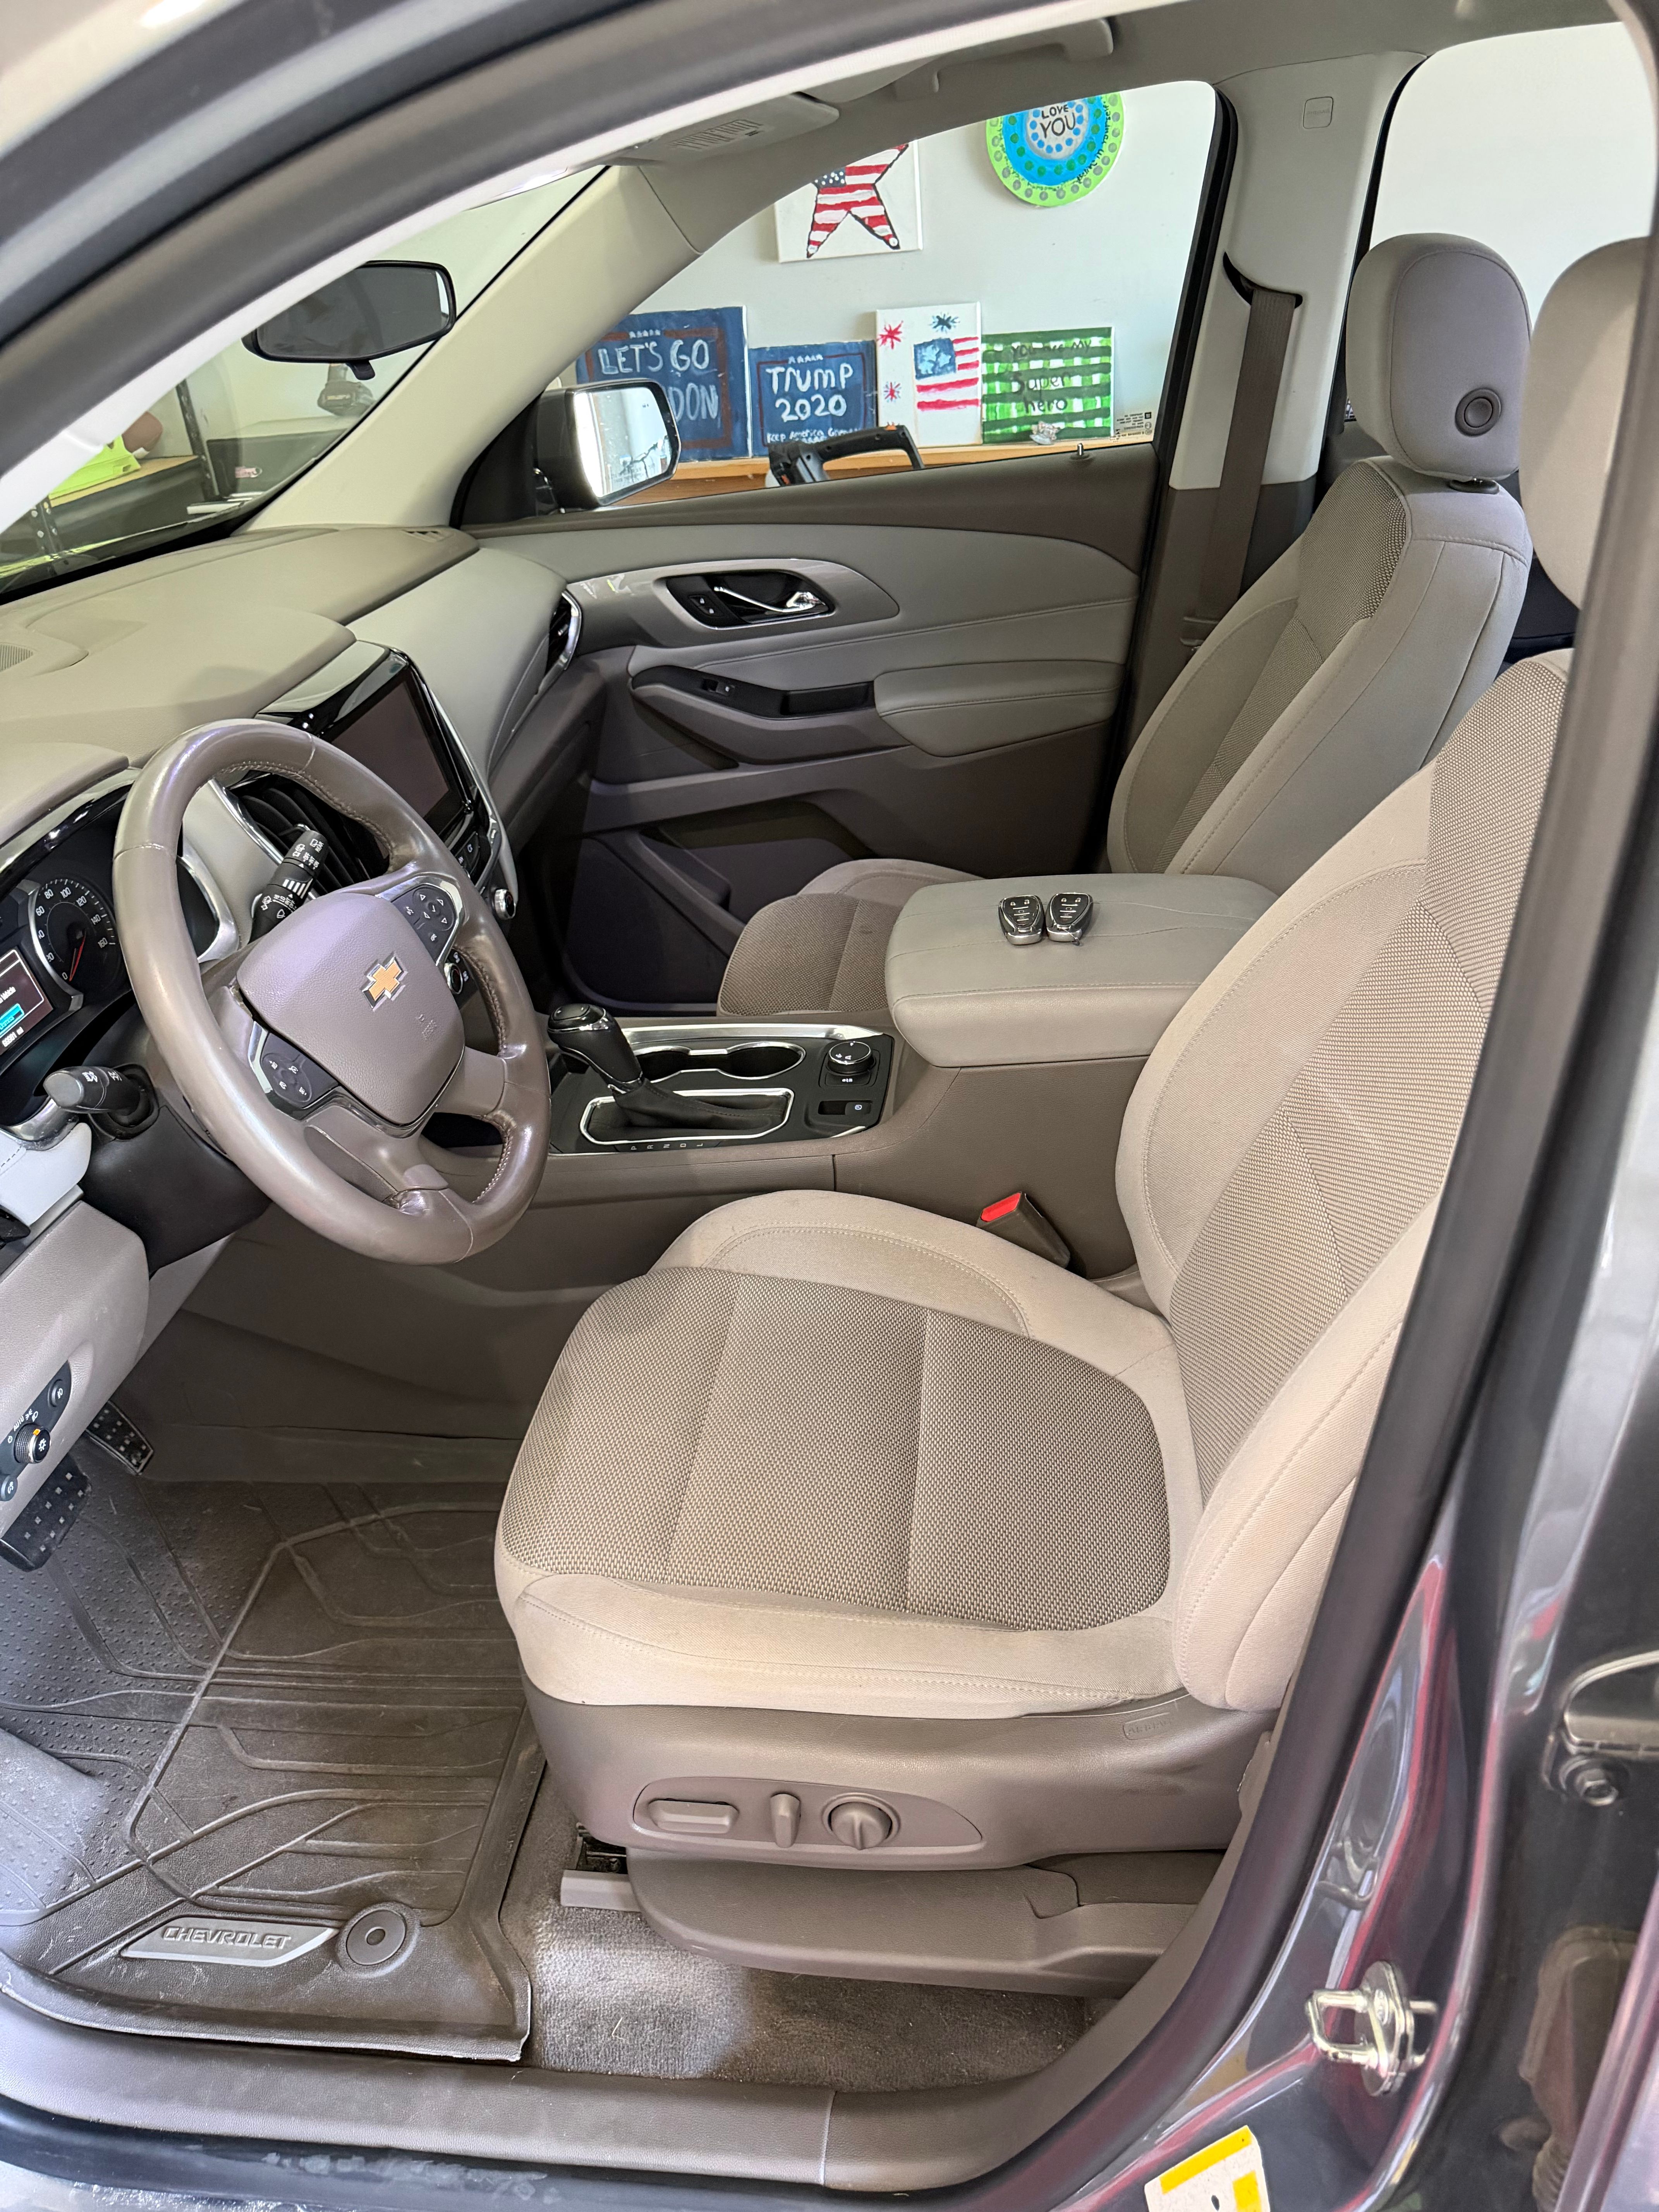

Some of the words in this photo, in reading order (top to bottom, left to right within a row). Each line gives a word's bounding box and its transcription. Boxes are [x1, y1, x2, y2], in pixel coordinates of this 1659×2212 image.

[1041, 104, 1069, 119] LOVE
[1040, 112, 1075, 139] YOU
[598, 341, 663, 374] LET'S
[670, 339, 709, 371] GO
[666, 383, 719, 421] DON
[775, 394, 847, 422] 2020
[1024, 396, 1068, 413] hero
[44, 889, 53, 899] 80
[60, 887, 71, 898] 100
[76, 896, 87, 907] 120
[36, 906, 45, 916] 60
[91, 914, 101, 925] 140
[98, 938, 108, 948] 160
[62, 972, 68, 980] 0
[163, 1927, 291, 1949] CHEVROLET
